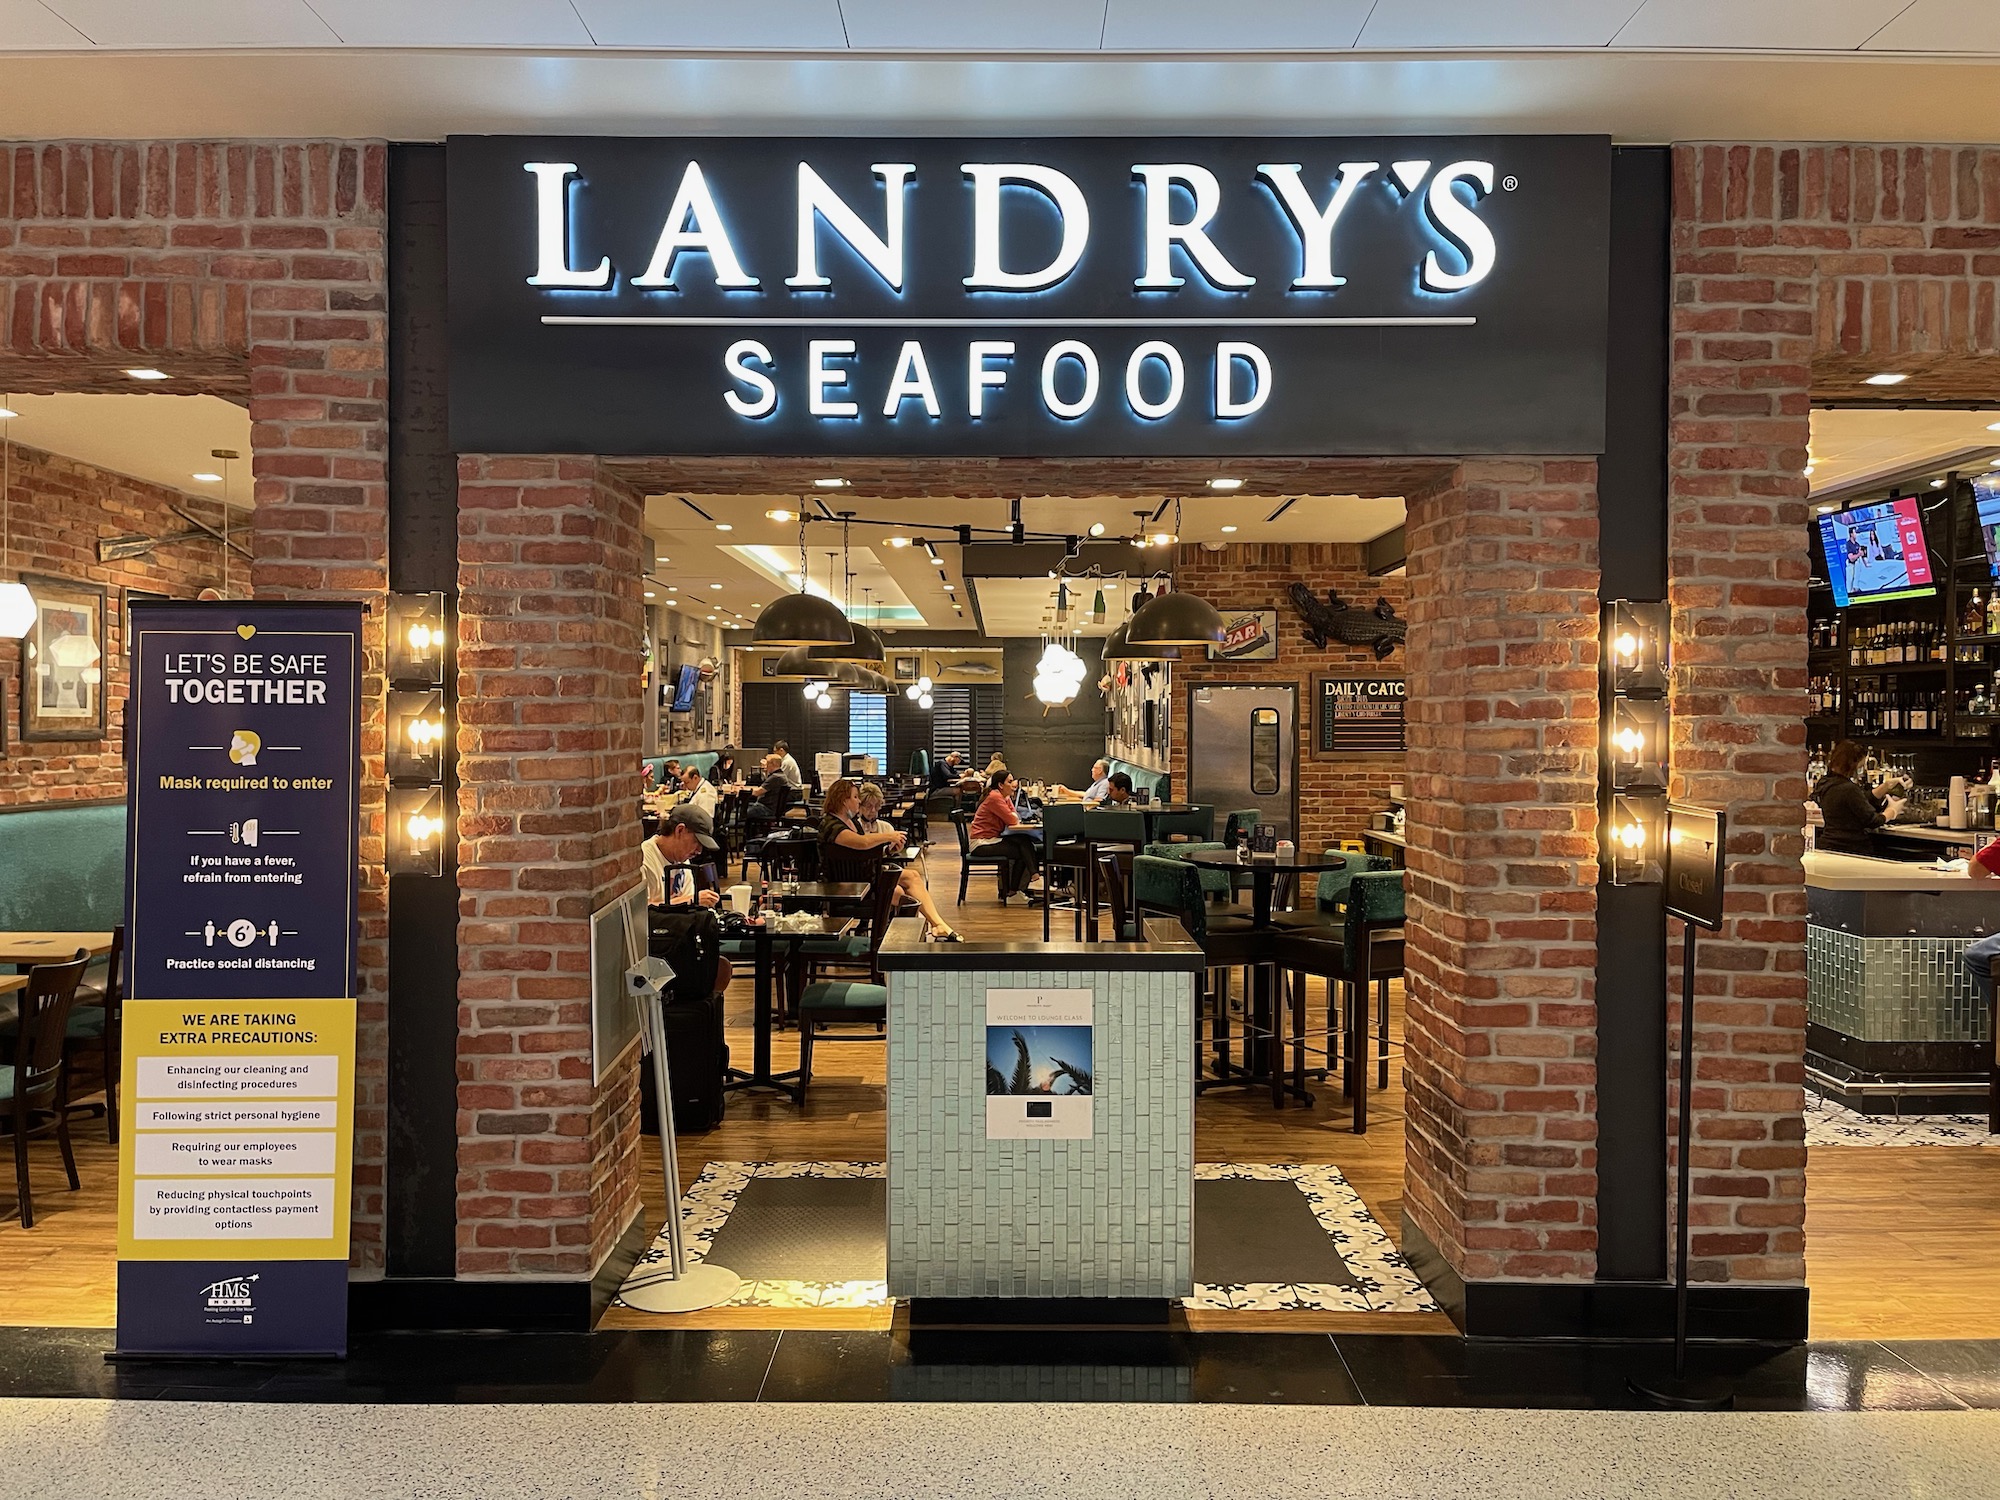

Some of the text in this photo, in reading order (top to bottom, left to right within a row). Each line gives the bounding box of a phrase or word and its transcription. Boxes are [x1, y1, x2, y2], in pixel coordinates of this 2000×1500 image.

[723, 338, 1274, 419] SEAFOOD
[166, 654, 326, 674] LET'S BE SAFE
[165, 679, 326, 703] TOGETHER
[1325, 682, 1404, 695] DAILY CATC
[160, 776, 332, 791] Mask required to enter
[191, 855, 199, 865] If
[202, 858, 221, 867] you
[225, 856, 251, 865] have
[264, 855, 295, 867] fever,
[184, 872, 302, 884] refrain from entering
[1680, 873, 1703, 895] Closed
[167, 958, 315, 970] Practice social distancing
[182, 1013, 296, 1026] WE ARE TAKING
[160, 1031, 318, 1045] EXTRA PRECAUTIONS:
[167, 1065, 222, 1076] Enhancing
[243, 1064, 287, 1076] cleaning
[289, 1065, 309, 1074] and
[177, 1079, 298, 1091] disinfecting procedures
[152, 1110, 321, 1122] Following strict personal hygiene
[172, 1142, 221, 1153] Requiring
[243, 1141, 297, 1153] employees
[198, 1157, 209, 1166] to
[239, 1156, 273, 1166] masks
[157, 1189, 312, 1201] Reducing physical touchpoints
[149, 1204, 319, 1216] by providing contactless payment
[214, 1219, 253, 1230] options
[211, 1283, 250, 1298] HMS
